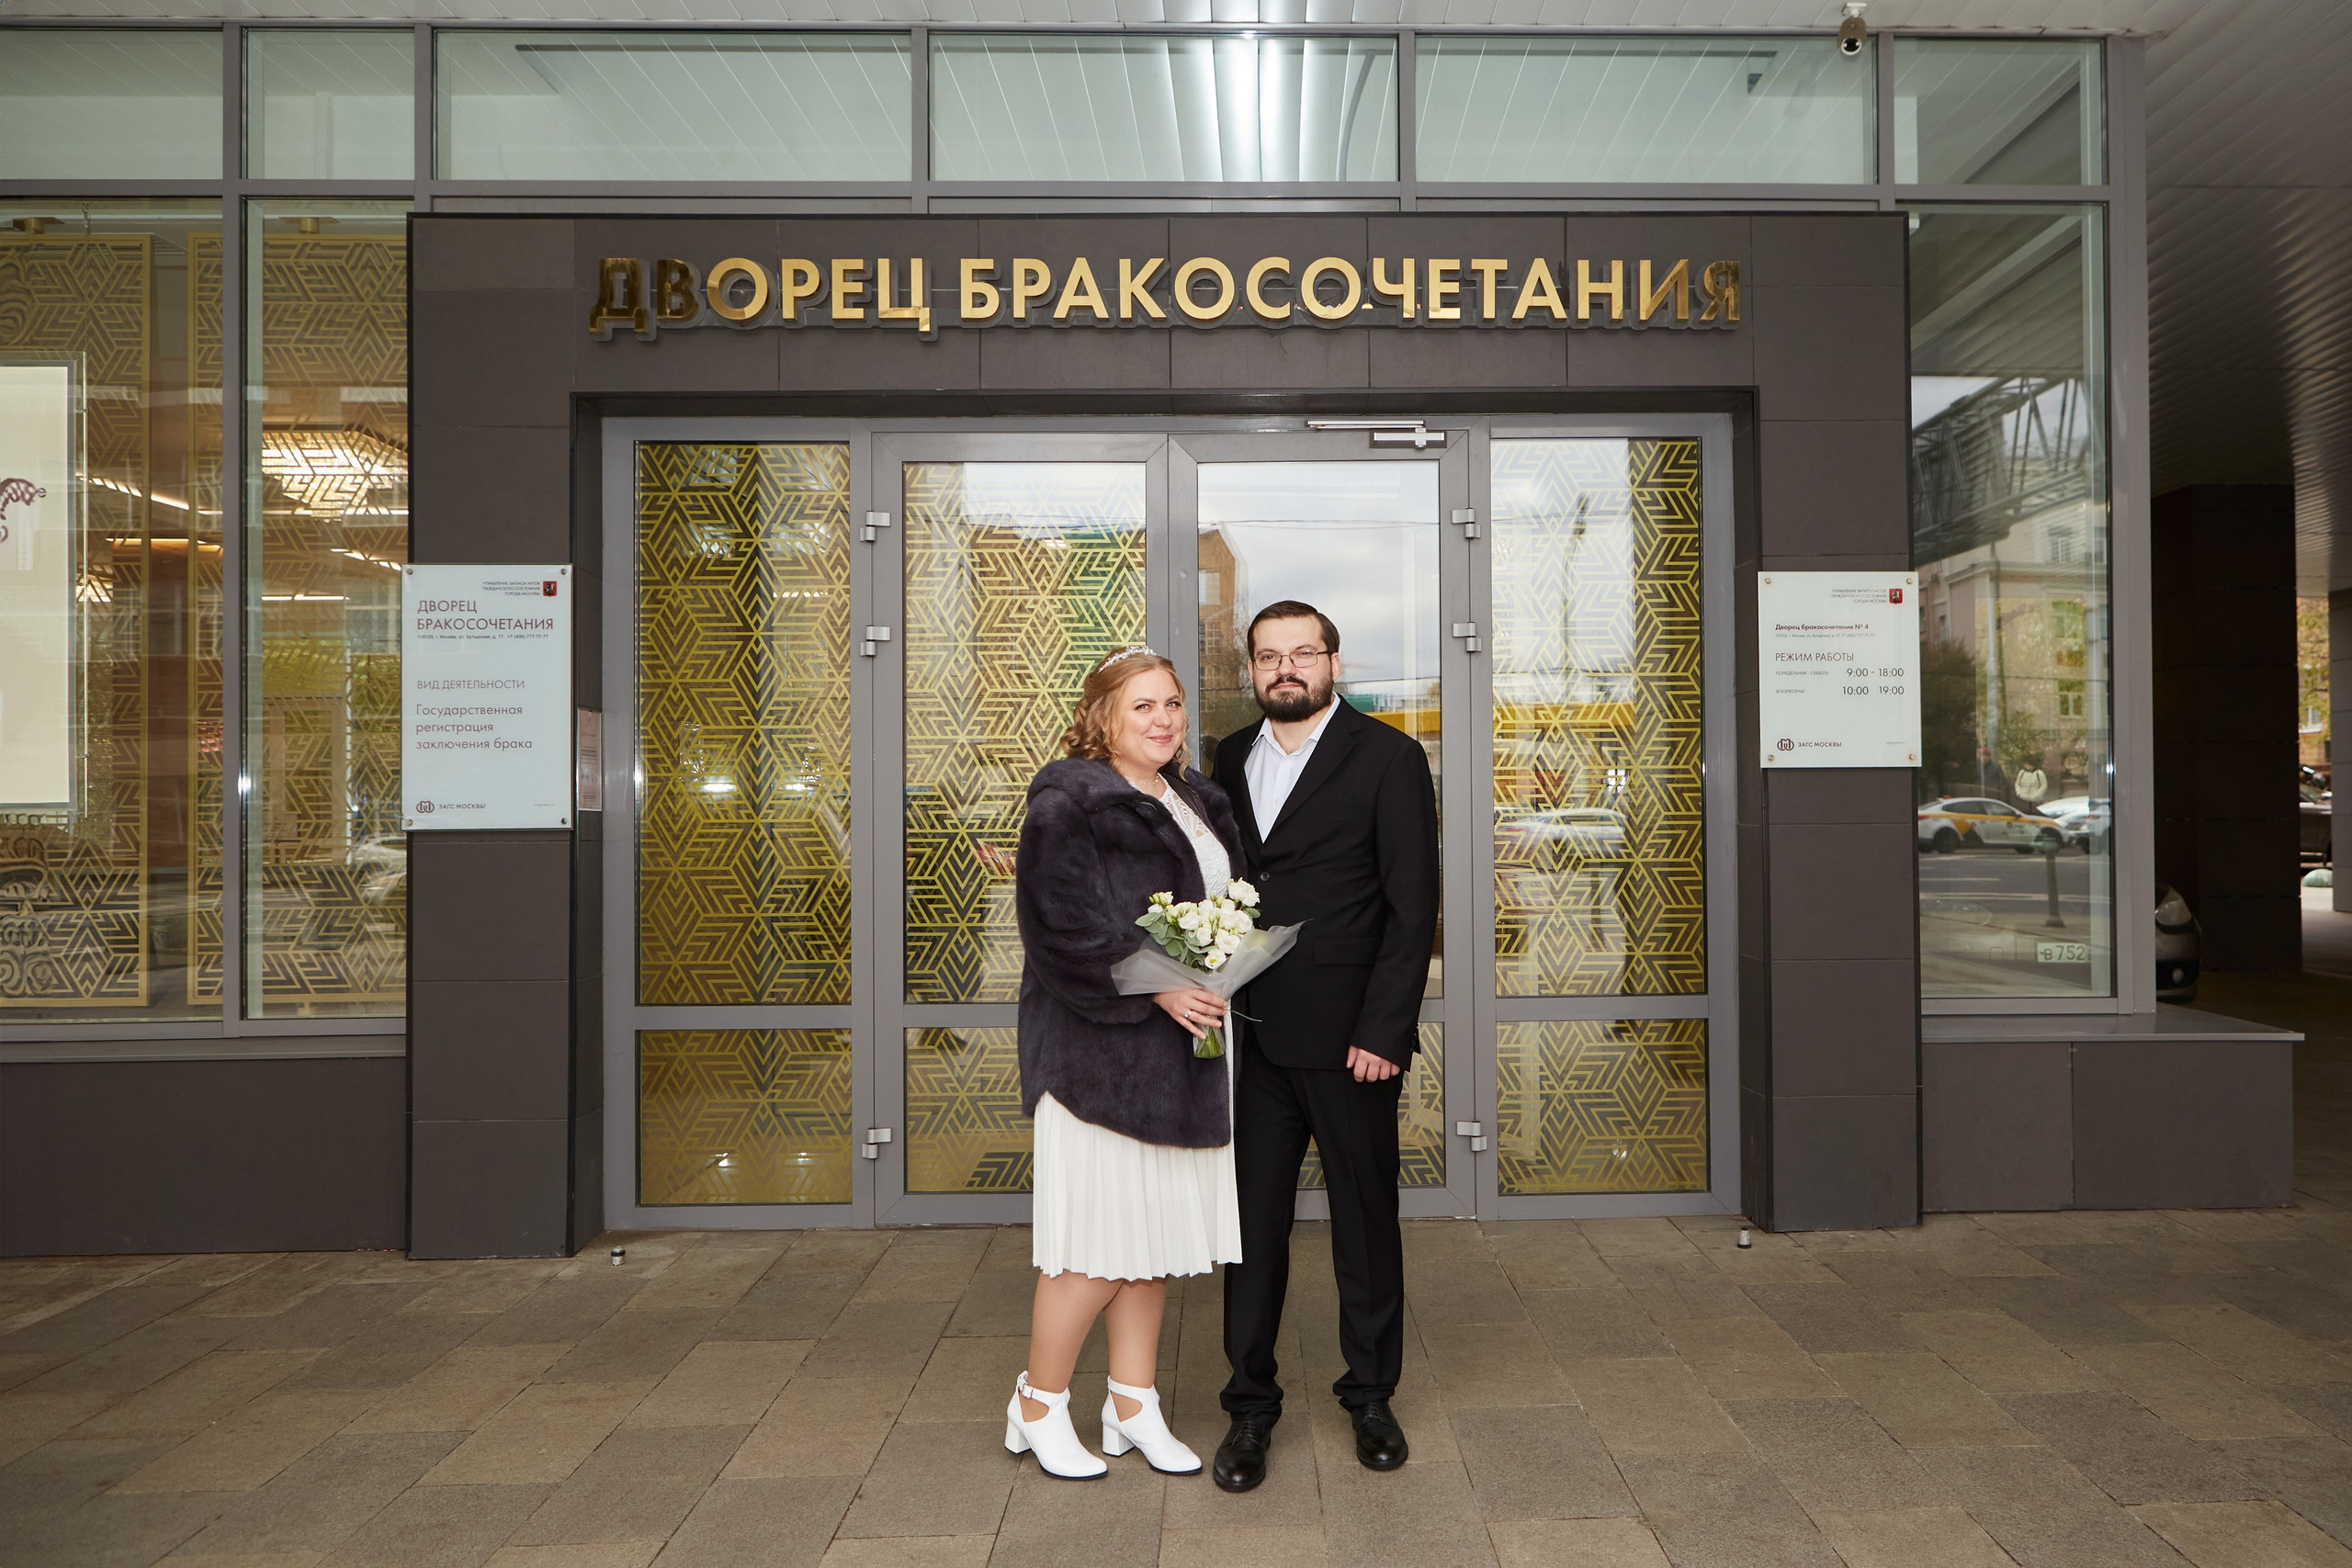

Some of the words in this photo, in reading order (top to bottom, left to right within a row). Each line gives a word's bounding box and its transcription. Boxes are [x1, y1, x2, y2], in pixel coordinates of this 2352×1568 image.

[588, 256, 932, 335] ДВОРЕЦ
[958, 256, 1741, 323] БРАКОСОЧЕТАНИЯ
[417, 600, 478, 615] ДВОРЕЦ
[417, 617, 554, 630] БРАКОСОЧЕТАНИЯ
[1801, 623, 1854, 631] бракосочетания
[1775, 652, 1813, 662] РЕЖИМ
[1815, 652, 1855, 662] РАБОТЫ
[1846, 668, 1869, 677] 9:00
[1878, 668, 1905, 677] 18:00
[416, 680, 439, 691] ВИД
[441, 679, 526, 691] ДЕЯТЕЛЬНОСТИ
[1842, 685, 1870, 695] 10:00
[1879, 685, 1905, 695] 19:00
[416, 704, 523, 716] Государственная
[416, 723, 494, 735] регистрация
[416, 739, 491, 750] заключения
[493, 738, 533, 750] брака
